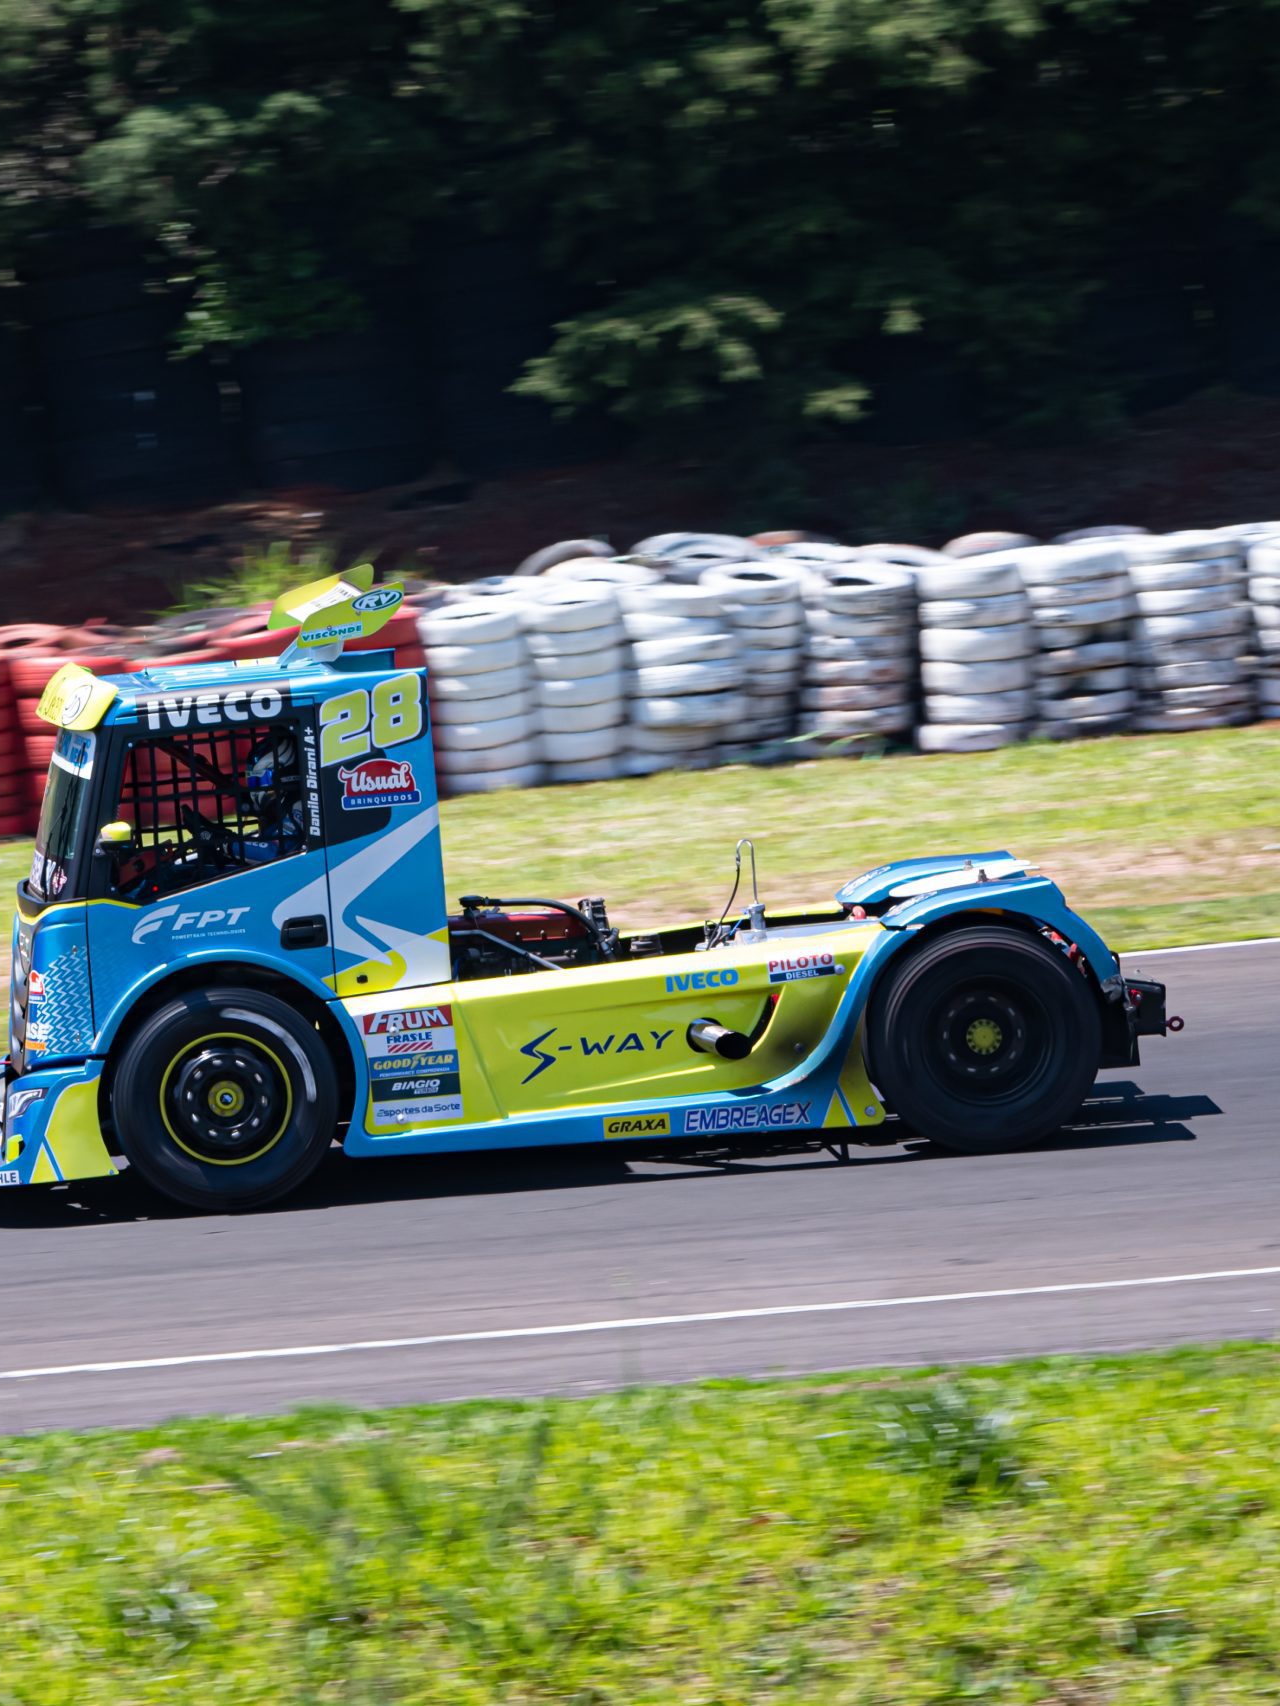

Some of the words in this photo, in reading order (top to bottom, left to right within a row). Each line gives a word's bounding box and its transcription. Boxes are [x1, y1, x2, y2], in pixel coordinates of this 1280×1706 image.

[361, 592, 399, 608] RV
[302, 625, 362, 641] VISCONDE
[147, 688, 282, 730] IVECO
[319, 672, 422, 767] 28
[304, 726, 315, 745] A+
[304, 747, 317, 789] Dirani
[341, 764, 411, 793] Usual
[350, 794, 413, 805] BRINQUEDOS
[308, 792, 321, 836] Danilo
[172, 907, 251, 930] FPT
[768, 953, 833, 972] PILOTO
[665, 969, 739, 993] IVECO
[785, 969, 820, 981] DIESEL
[368, 1006, 448, 1033] FRUM
[373, 1054, 454, 1070] GOODYEAR
[520, 1027, 675, 1085] S-WAY
[391, 1079, 441, 1092] BIAGIO
[377, 1105, 420, 1118] Esportes
[421, 1105, 434, 1113] da
[434, 1103, 461, 1112] Sorte
[684, 1102, 813, 1133] EMBREAGEX
[608, 1118, 667, 1133] GRAXA
